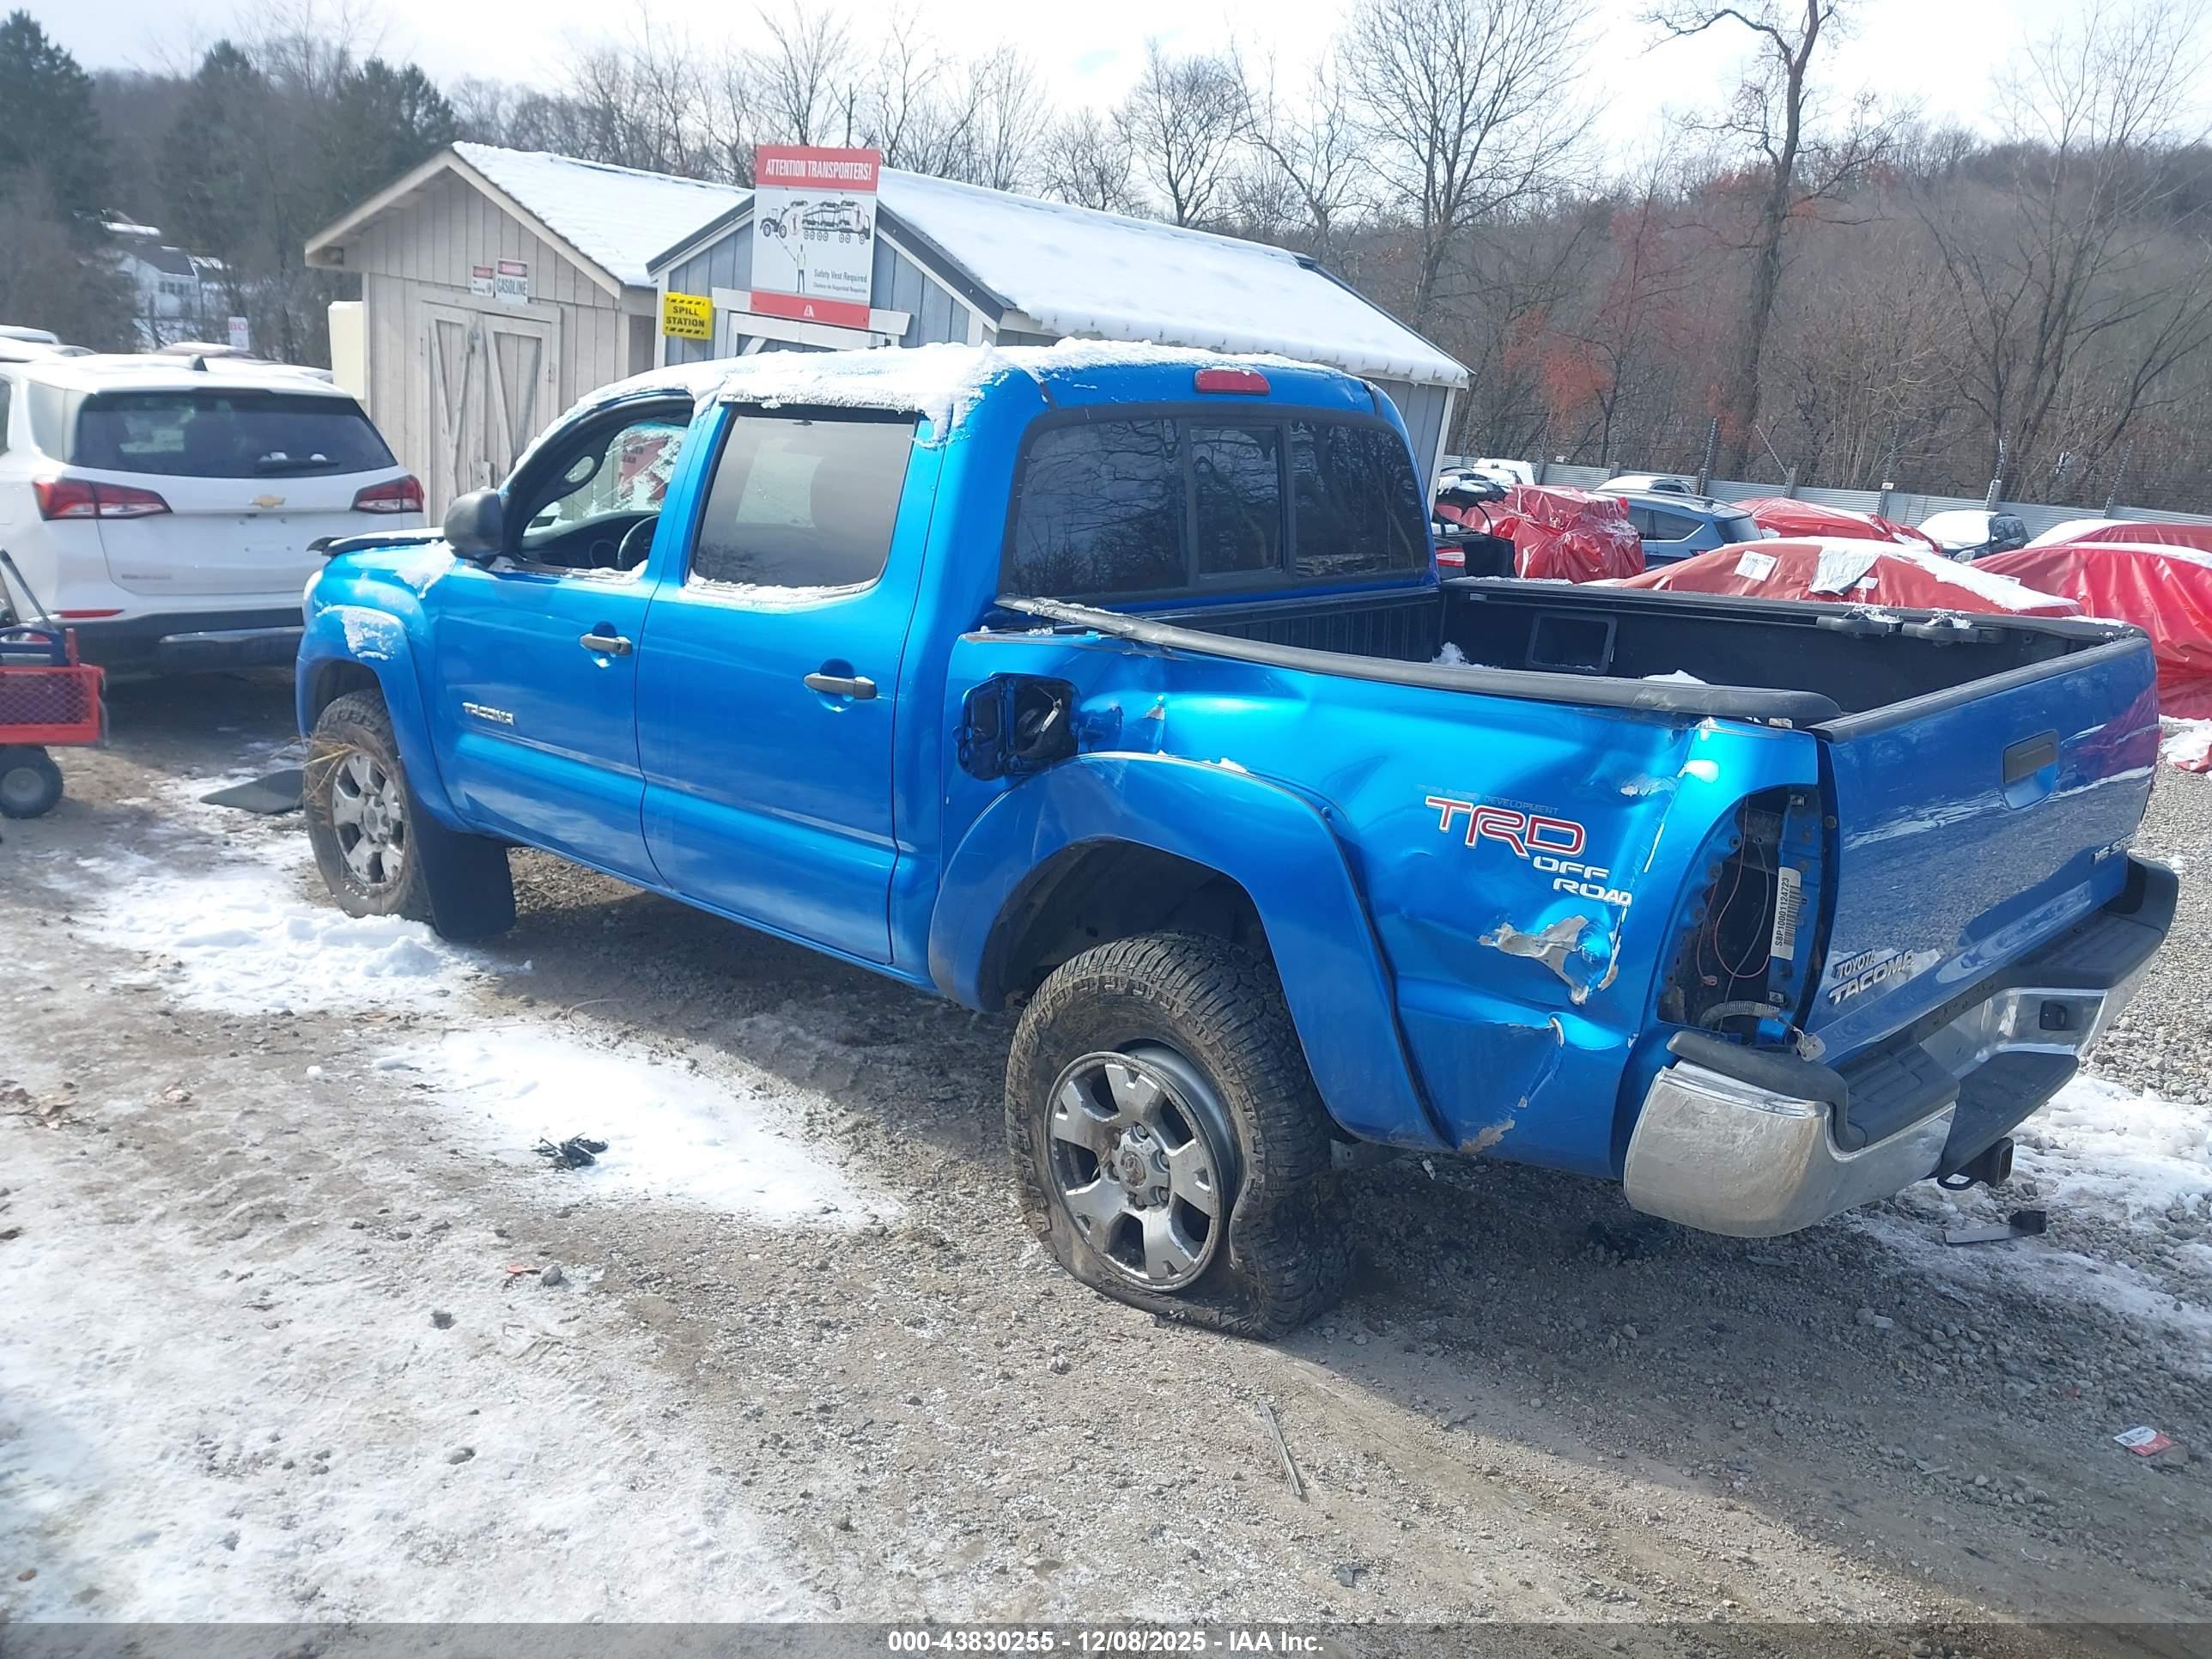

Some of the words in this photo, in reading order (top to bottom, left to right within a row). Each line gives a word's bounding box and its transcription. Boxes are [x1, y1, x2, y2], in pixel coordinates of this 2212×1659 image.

[765, 158, 806, 177] ATTENTION
[807, 160, 872, 181] TRANSPORTERS!
[814, 268, 830, 281] Safety
[831, 270, 842, 280] Vest
[843, 270, 866, 283] Required
[665, 315, 705, 328] STATION
[672, 305, 700, 317] SPILL
[1483, 794, 1560, 815] DEVELOPMENT
[1425, 794, 1587, 860] TRD
[1533, 855, 1610, 880] OFF
[1553, 878, 1632, 907] ROAD
[1835, 949, 1875, 980] TOYOTA
[1829, 949, 1915, 1006] TACOMA
